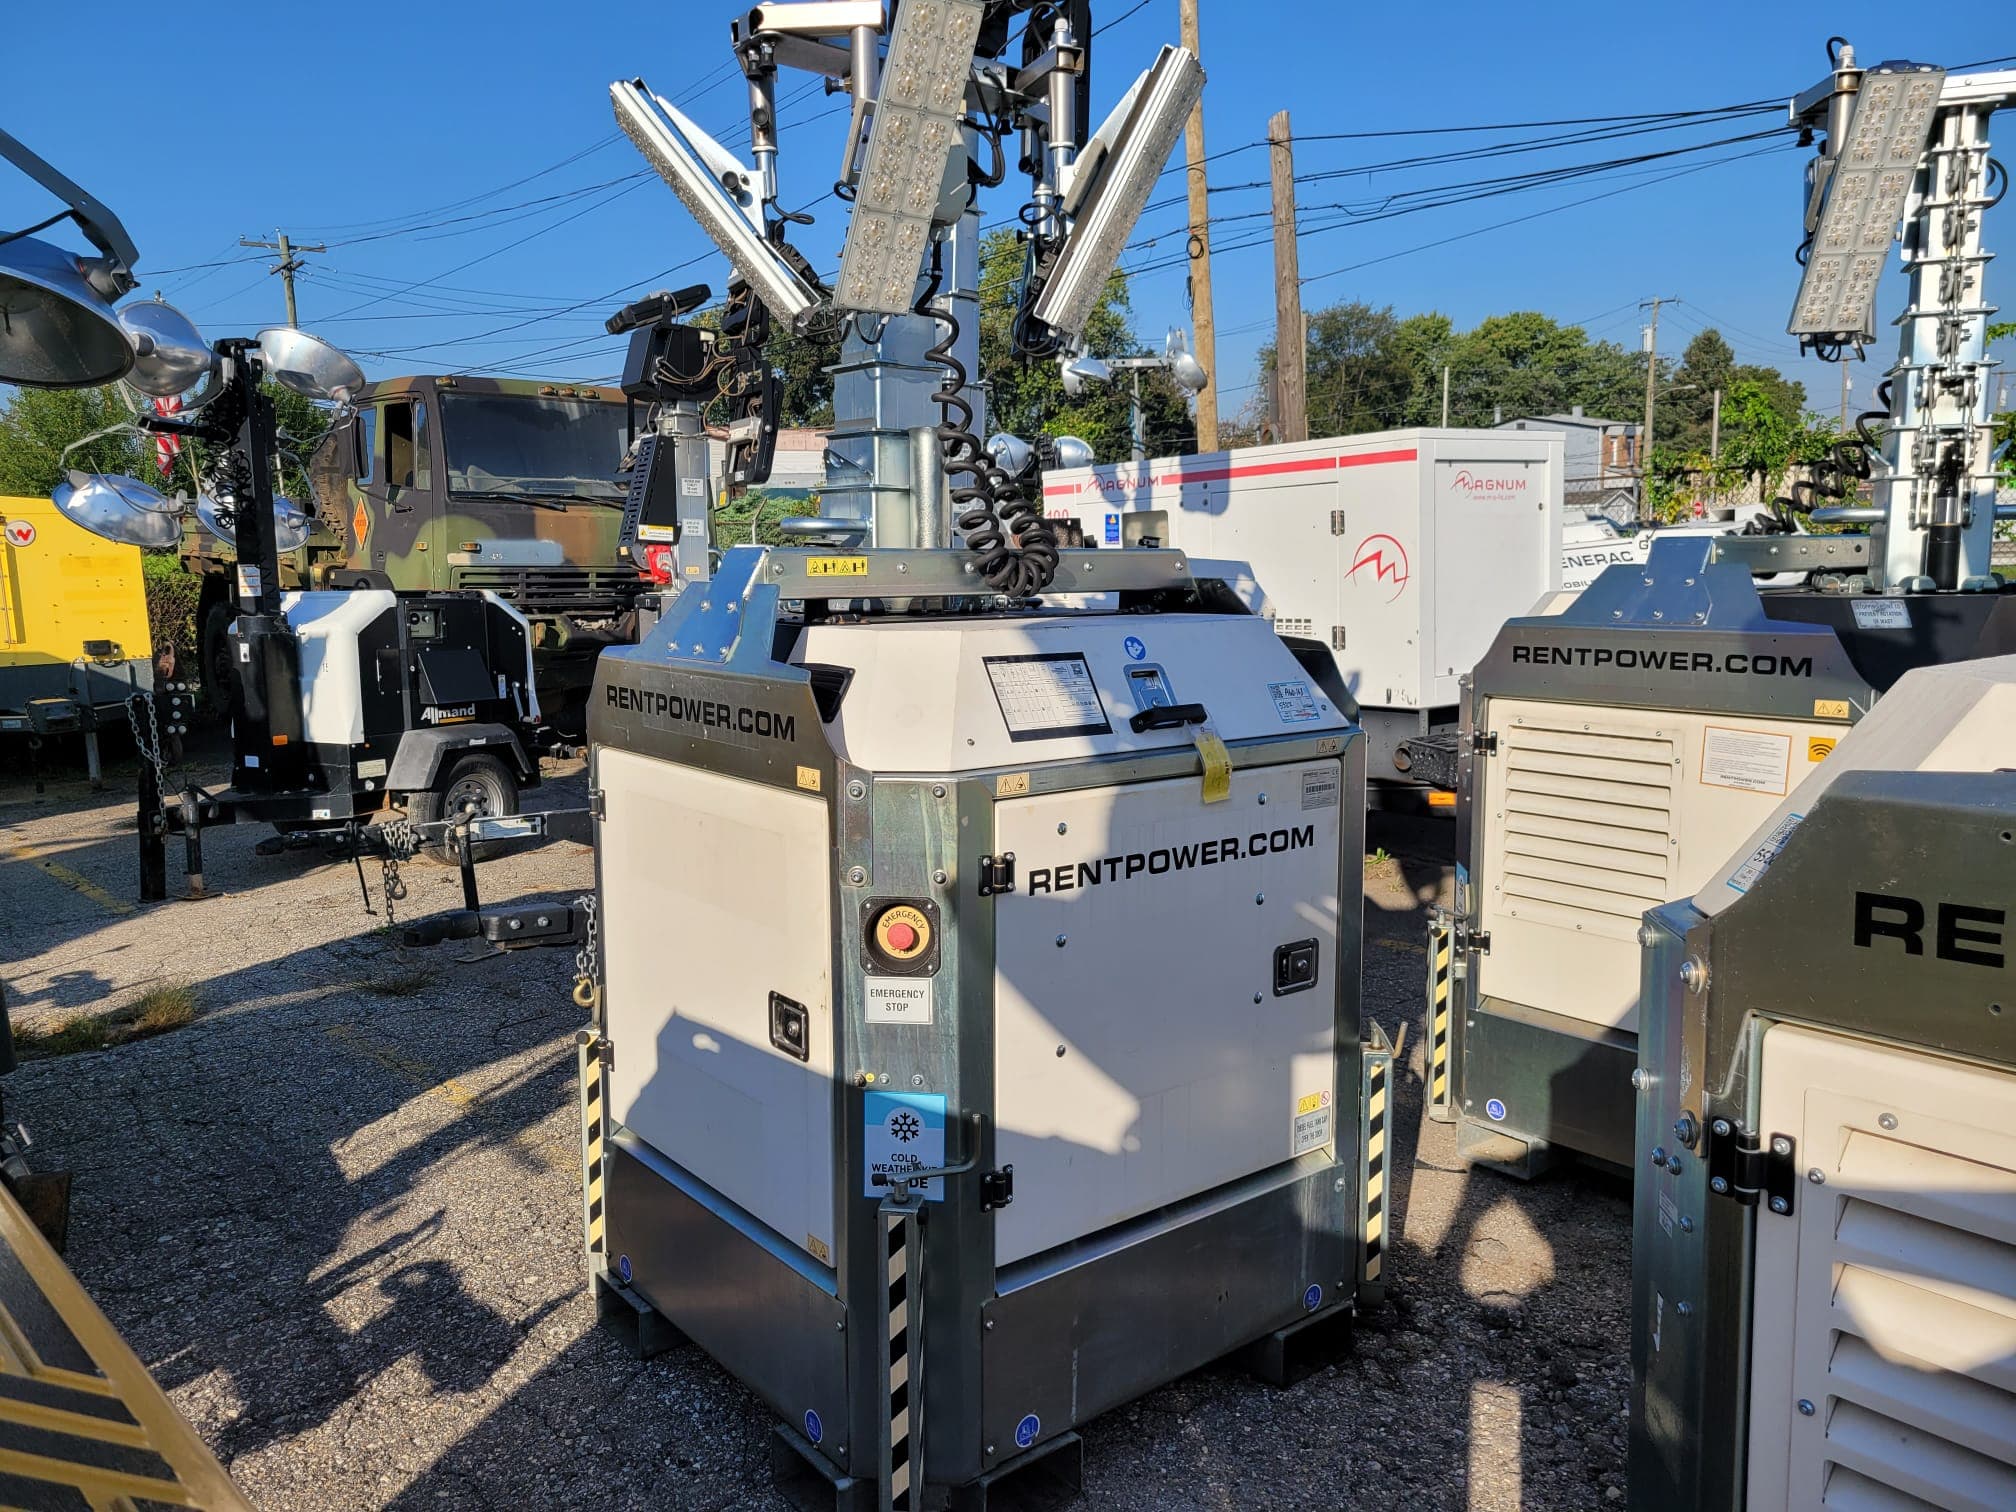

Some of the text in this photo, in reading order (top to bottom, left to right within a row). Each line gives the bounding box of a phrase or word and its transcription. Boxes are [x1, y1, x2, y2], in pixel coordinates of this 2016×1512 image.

[1085, 474, 1160, 493] MAGNUM
[1450, 470, 1526, 491] MAGNUM
[1562, 551, 1634, 569] ENERAC
[1562, 580, 1593, 590] OBIL
[1512, 645, 1813, 679] RENTPOWER.COM
[420, 703, 476, 725] Allmand
[606, 684, 795, 742] RENTPOWER.COM
[1028, 825, 1315, 897] RENTPOWER.COM
[882, 910, 926, 930] EMERGENCY
[1853, 891, 2006, 968] RE
[870, 988, 925, 999] EMERGENCY
[885, 1002, 909, 1012] STOP
[890, 1153, 918, 1163] COLD
